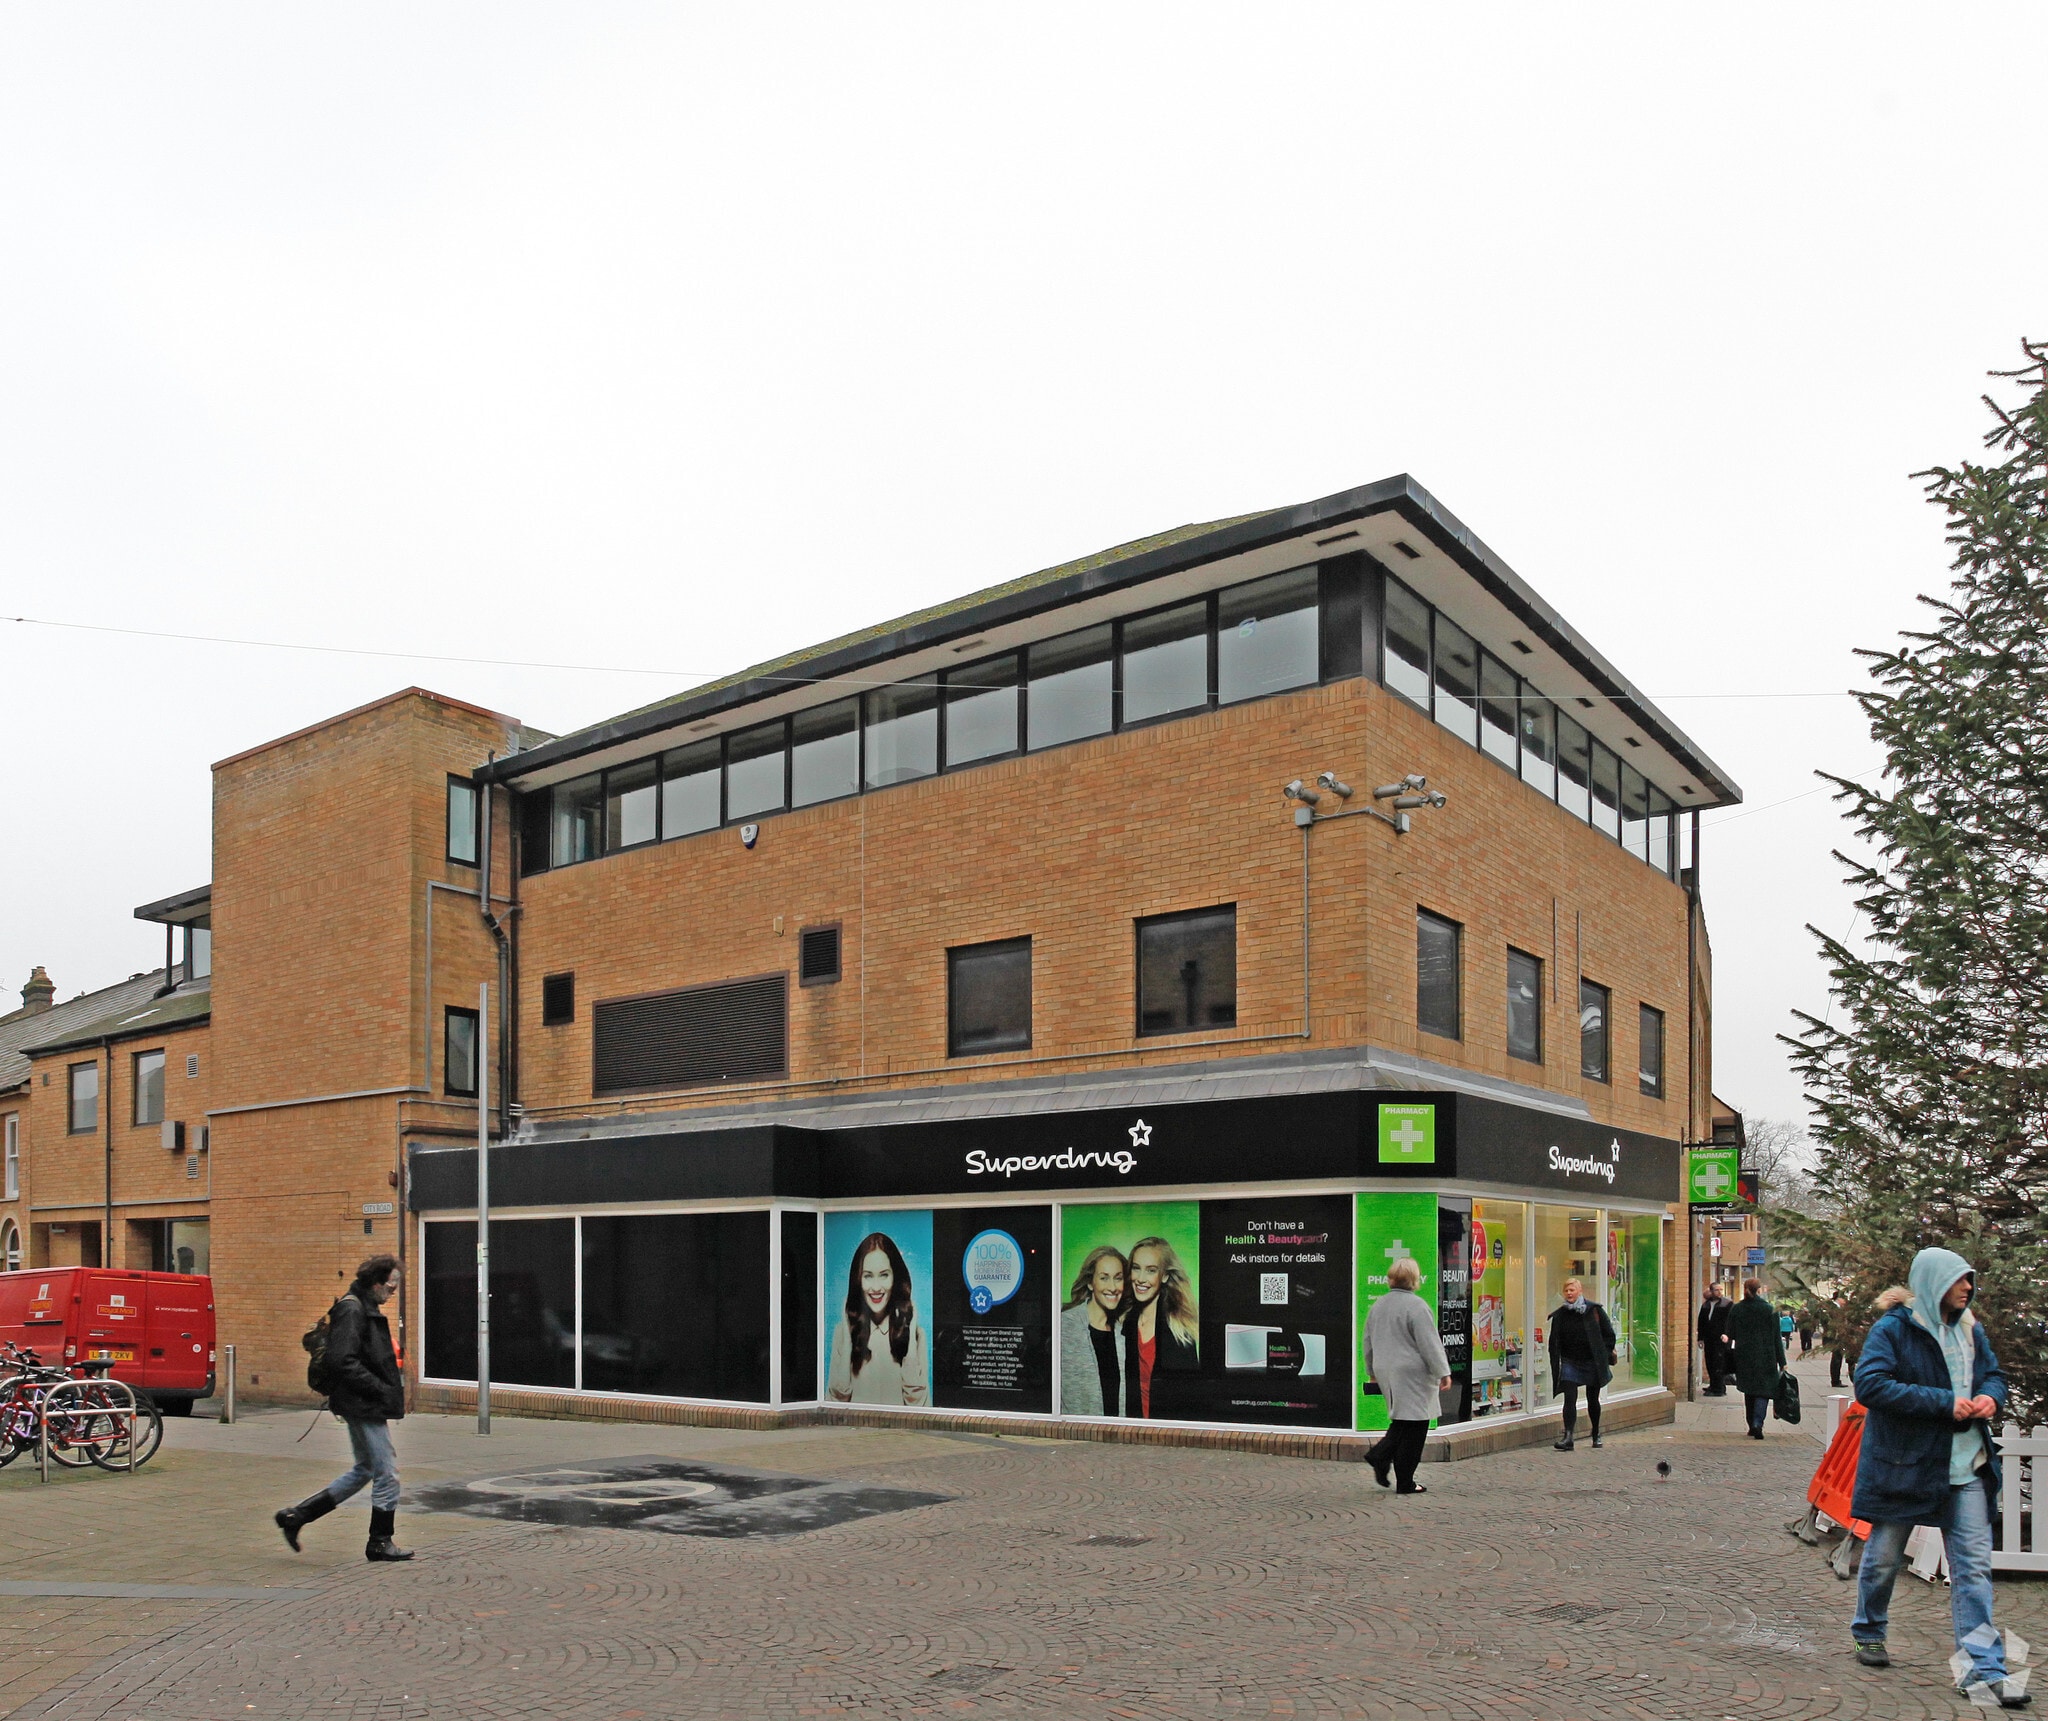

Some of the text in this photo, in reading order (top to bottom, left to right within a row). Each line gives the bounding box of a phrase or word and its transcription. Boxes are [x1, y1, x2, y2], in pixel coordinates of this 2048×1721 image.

[965, 1147, 1137, 1178] Superdrug
[1549, 1146, 1615, 1184] Superdrug
[1247, 1221, 1305, 1231] Don't have a
[1225, 1235, 1257, 1245] Health
[1258, 1234, 1266, 1244] &
[974, 1244, 1012, 1260] 100%
[1230, 1253, 1326, 1263] Ask instore for details
[1442, 1270, 1468, 1282] BEAUTY
[1442, 1300, 1468, 1309] FRAGRANCE
[99, 1306, 134, 1315] Royal Mail
[1442, 1311, 1468, 1332] BABY
[1442, 1334, 1465, 1346] DRINKS
[114, 1351, 131, 1360] ZKV
